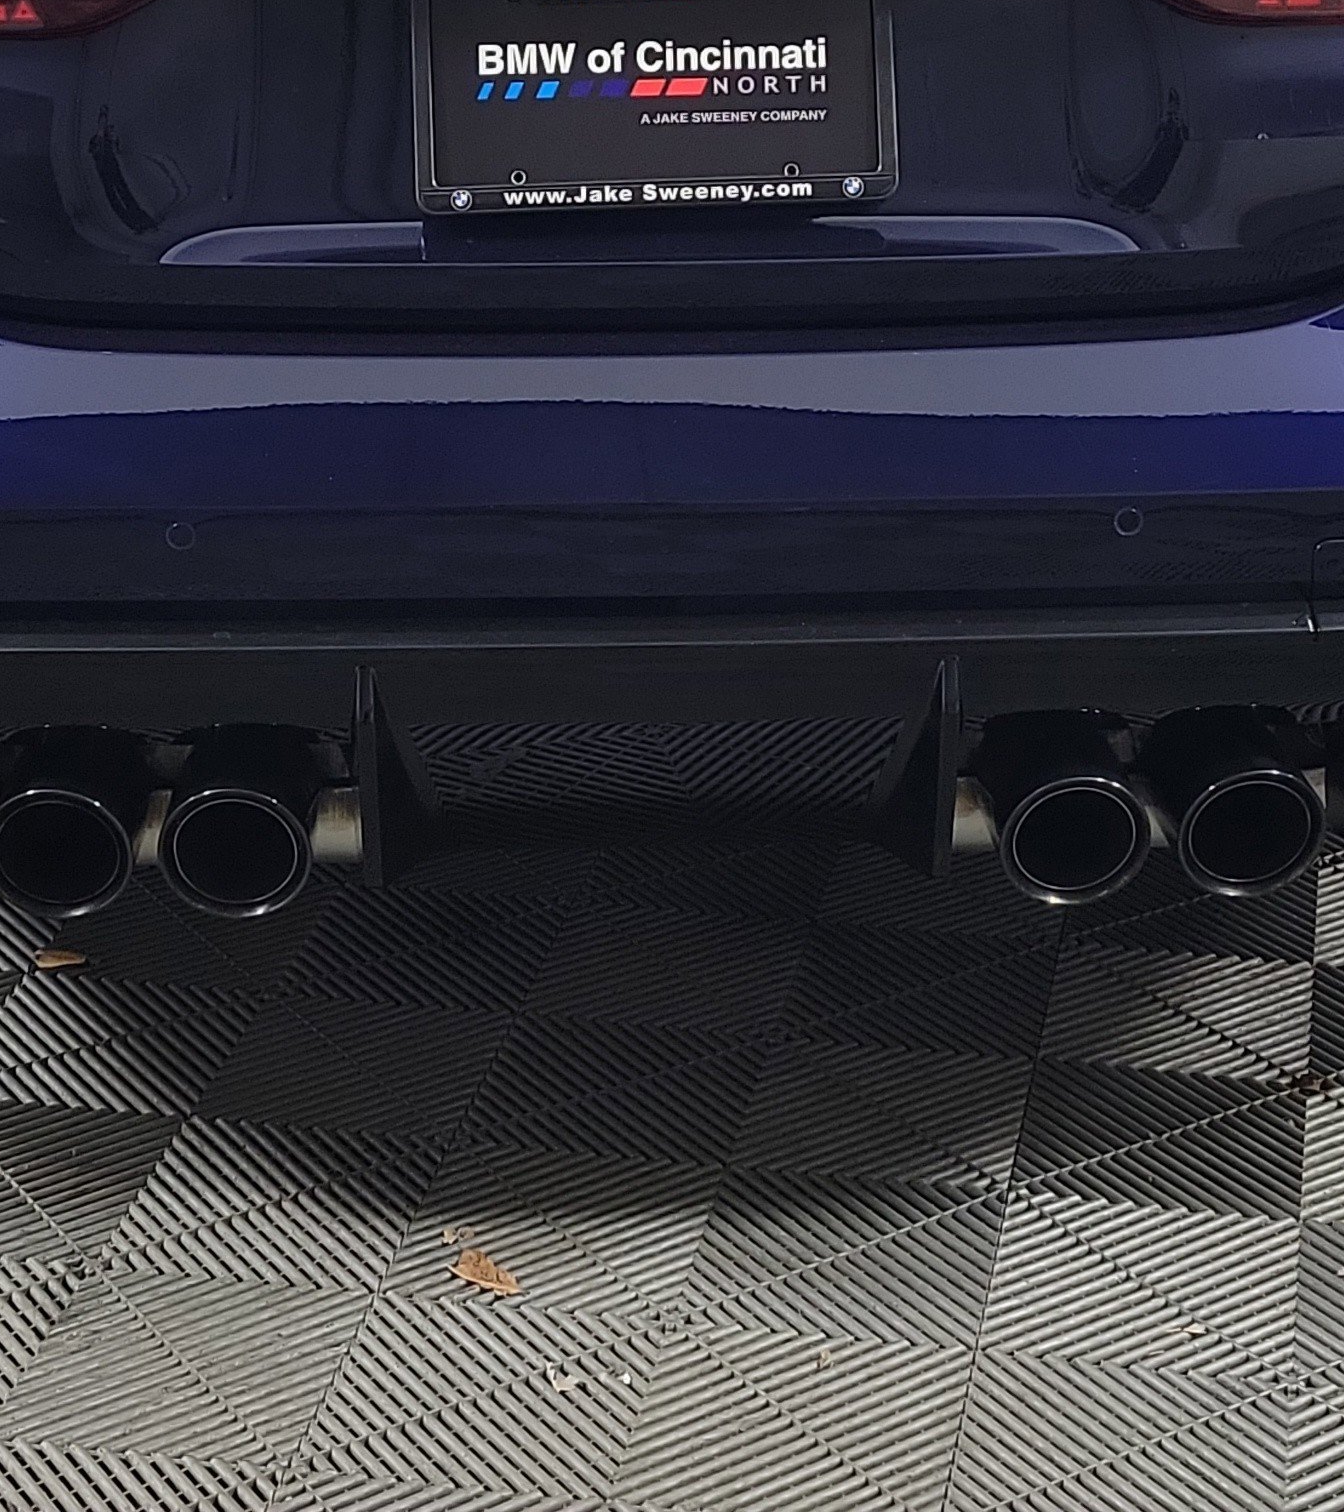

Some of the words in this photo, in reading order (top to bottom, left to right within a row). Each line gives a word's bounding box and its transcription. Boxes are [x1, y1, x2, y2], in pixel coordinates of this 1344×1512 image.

[477, 43, 575, 76] BMW
[587, 42, 625, 74] of
[636, 37, 826, 73] Cincinnati
[713, 75, 826, 94] NORTH
[640, 113, 651, 124] A
[653, 112, 689, 124] JAKE
[691, 111, 757, 123] SWEENEY
[760, 109, 827, 122] COMPANY
[503, 185, 633, 206] www.Jake
[642, 181, 813, 204] Sweeney.com
